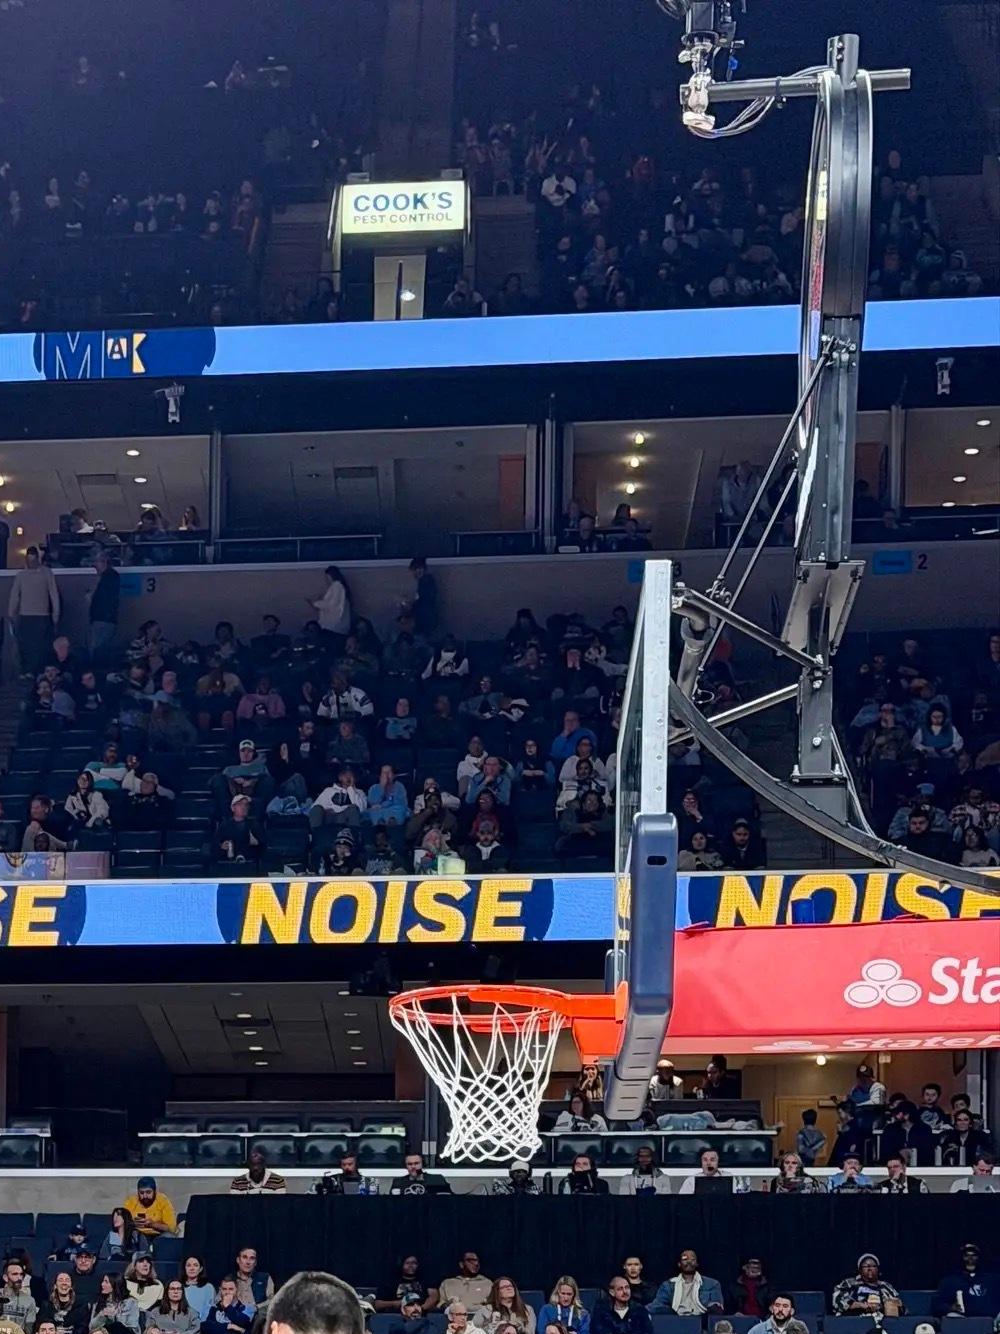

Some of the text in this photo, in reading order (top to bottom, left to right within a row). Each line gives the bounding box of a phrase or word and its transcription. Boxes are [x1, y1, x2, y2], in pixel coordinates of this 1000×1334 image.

[353, 191, 453, 212] COOK'S
[353, 212, 453, 225] PEST CONTROL
[917, 554, 928, 570] 2
[146, 577, 156, 593] 3
[240, 878, 533, 944] NOISE
